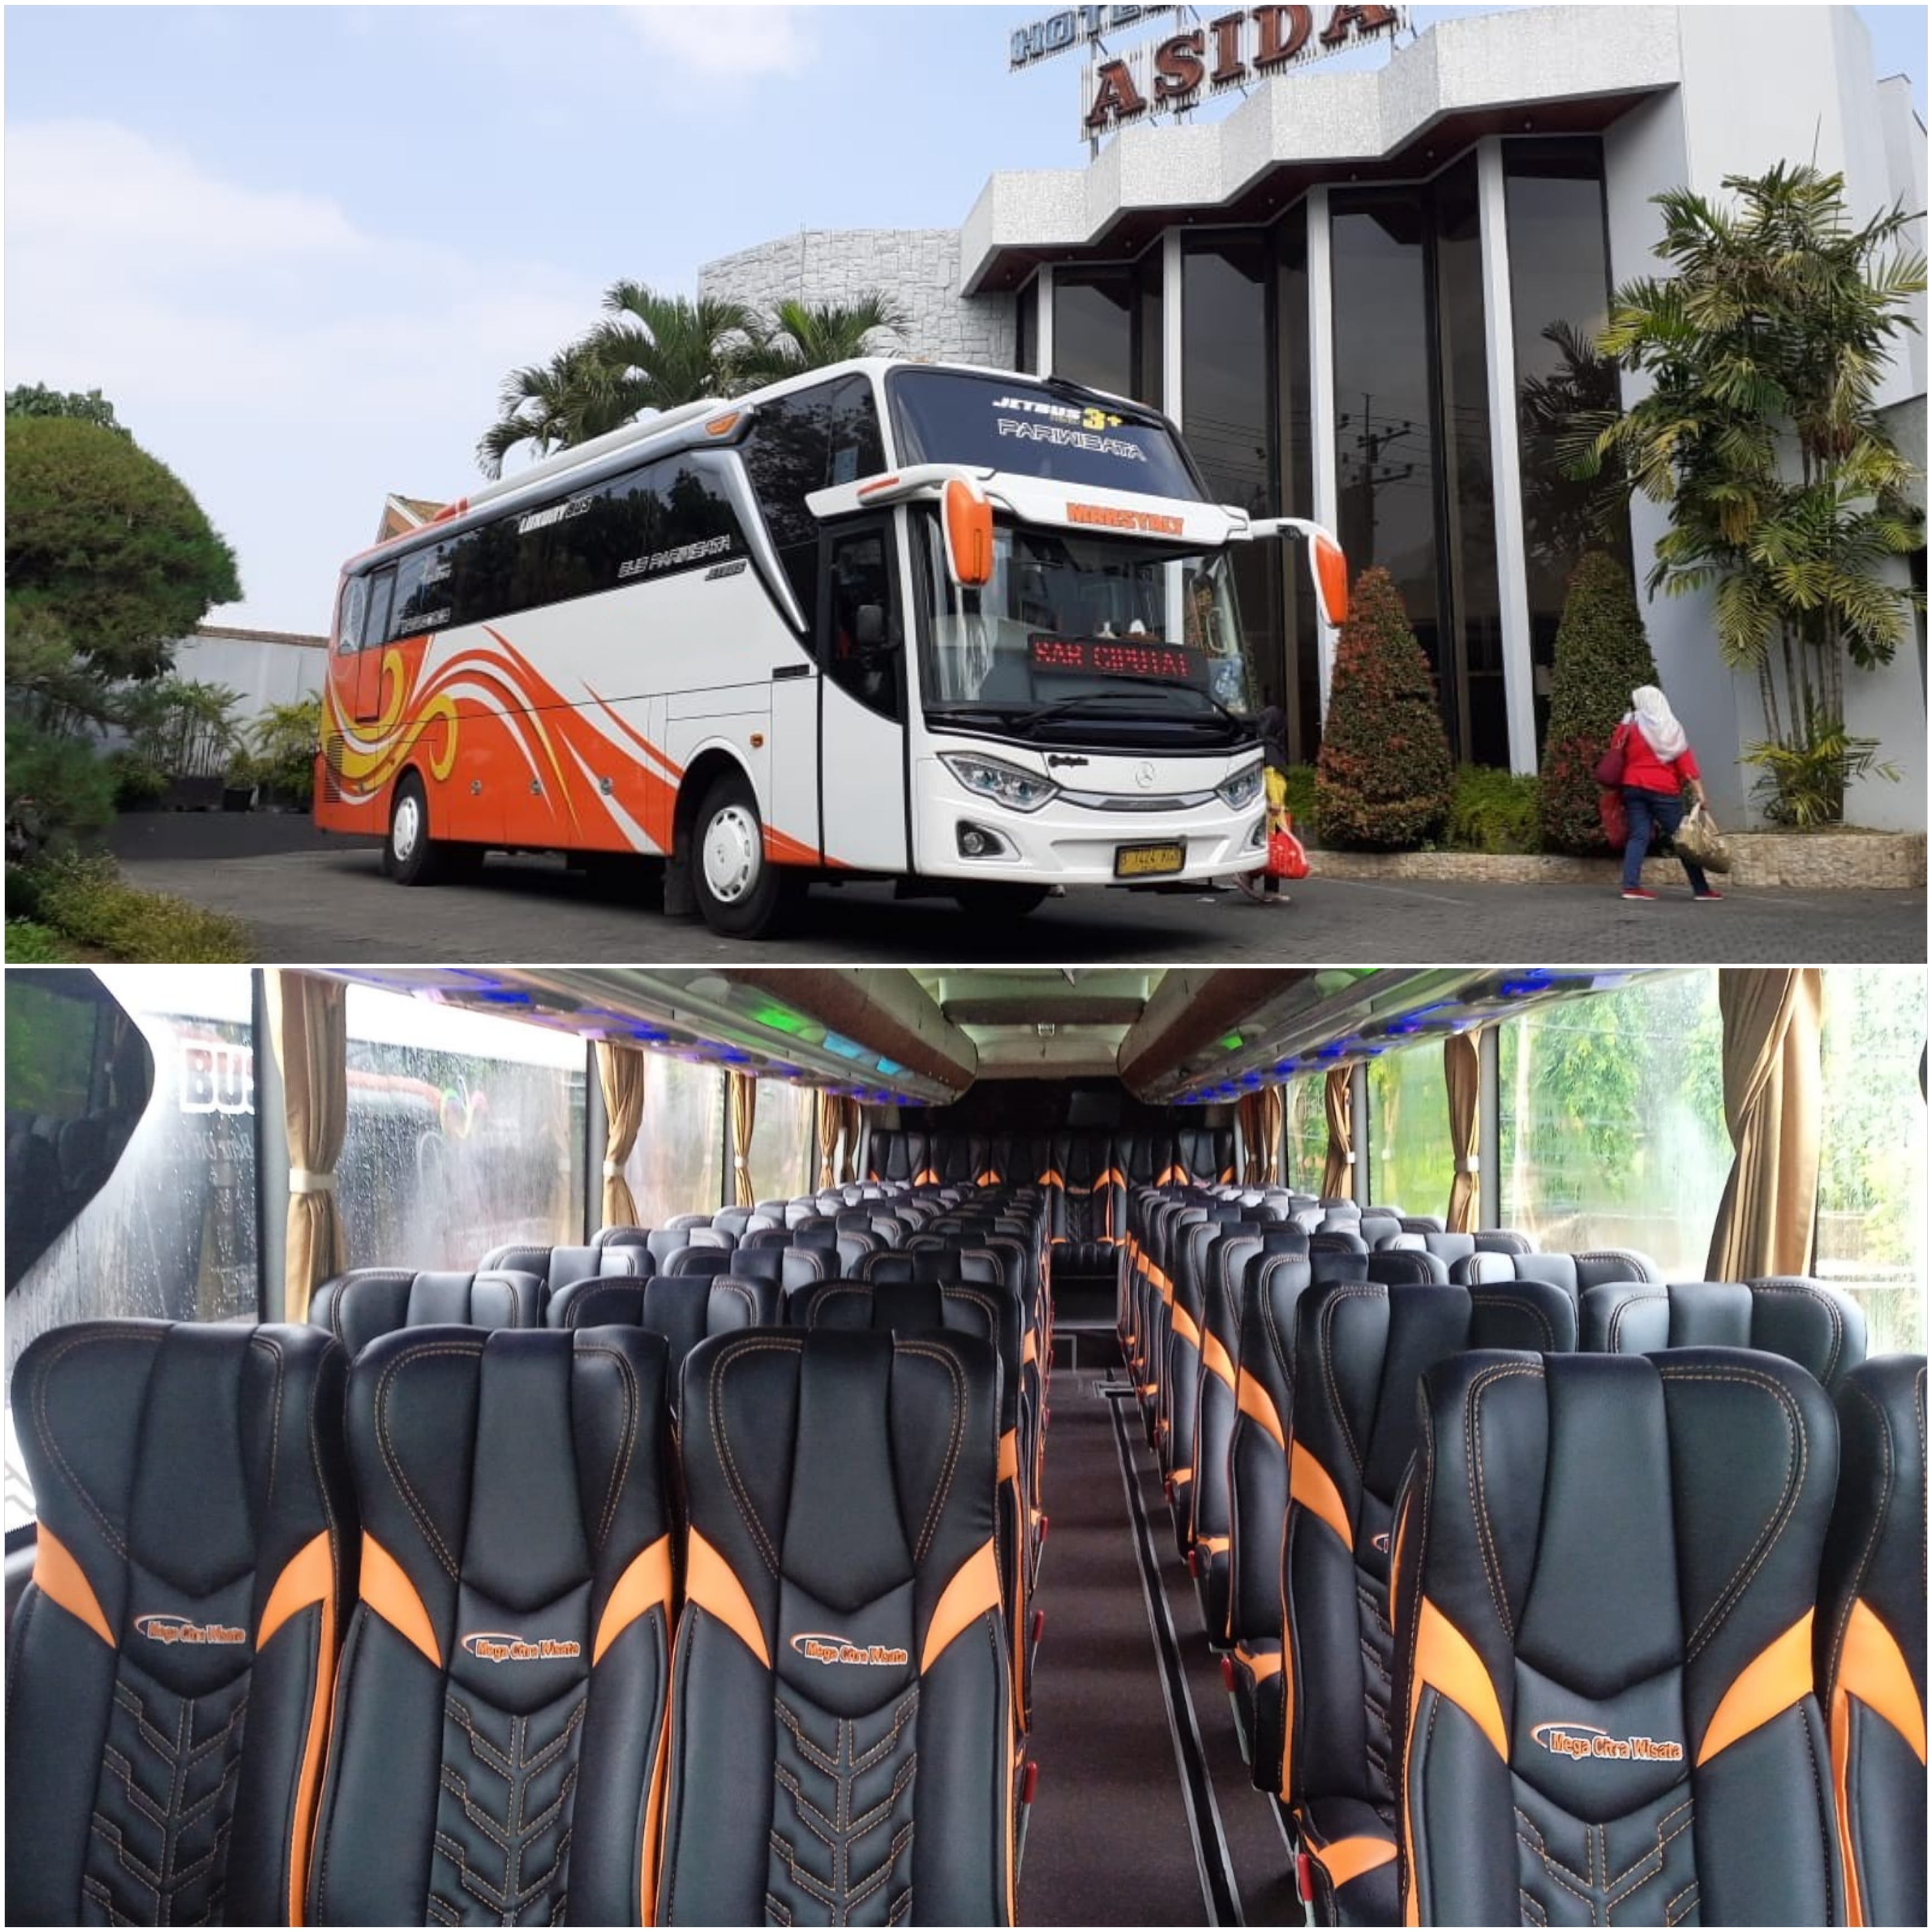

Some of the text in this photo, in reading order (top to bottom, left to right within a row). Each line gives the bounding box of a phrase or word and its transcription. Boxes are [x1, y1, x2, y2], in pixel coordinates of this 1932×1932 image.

[1086, 5, 1398, 126] ASIDA
[992, 397, 1081, 421] JETBUS
[181, 1041, 255, 1115] BU
[1550, 1730, 1683, 1761] Mega Citra Wisata
